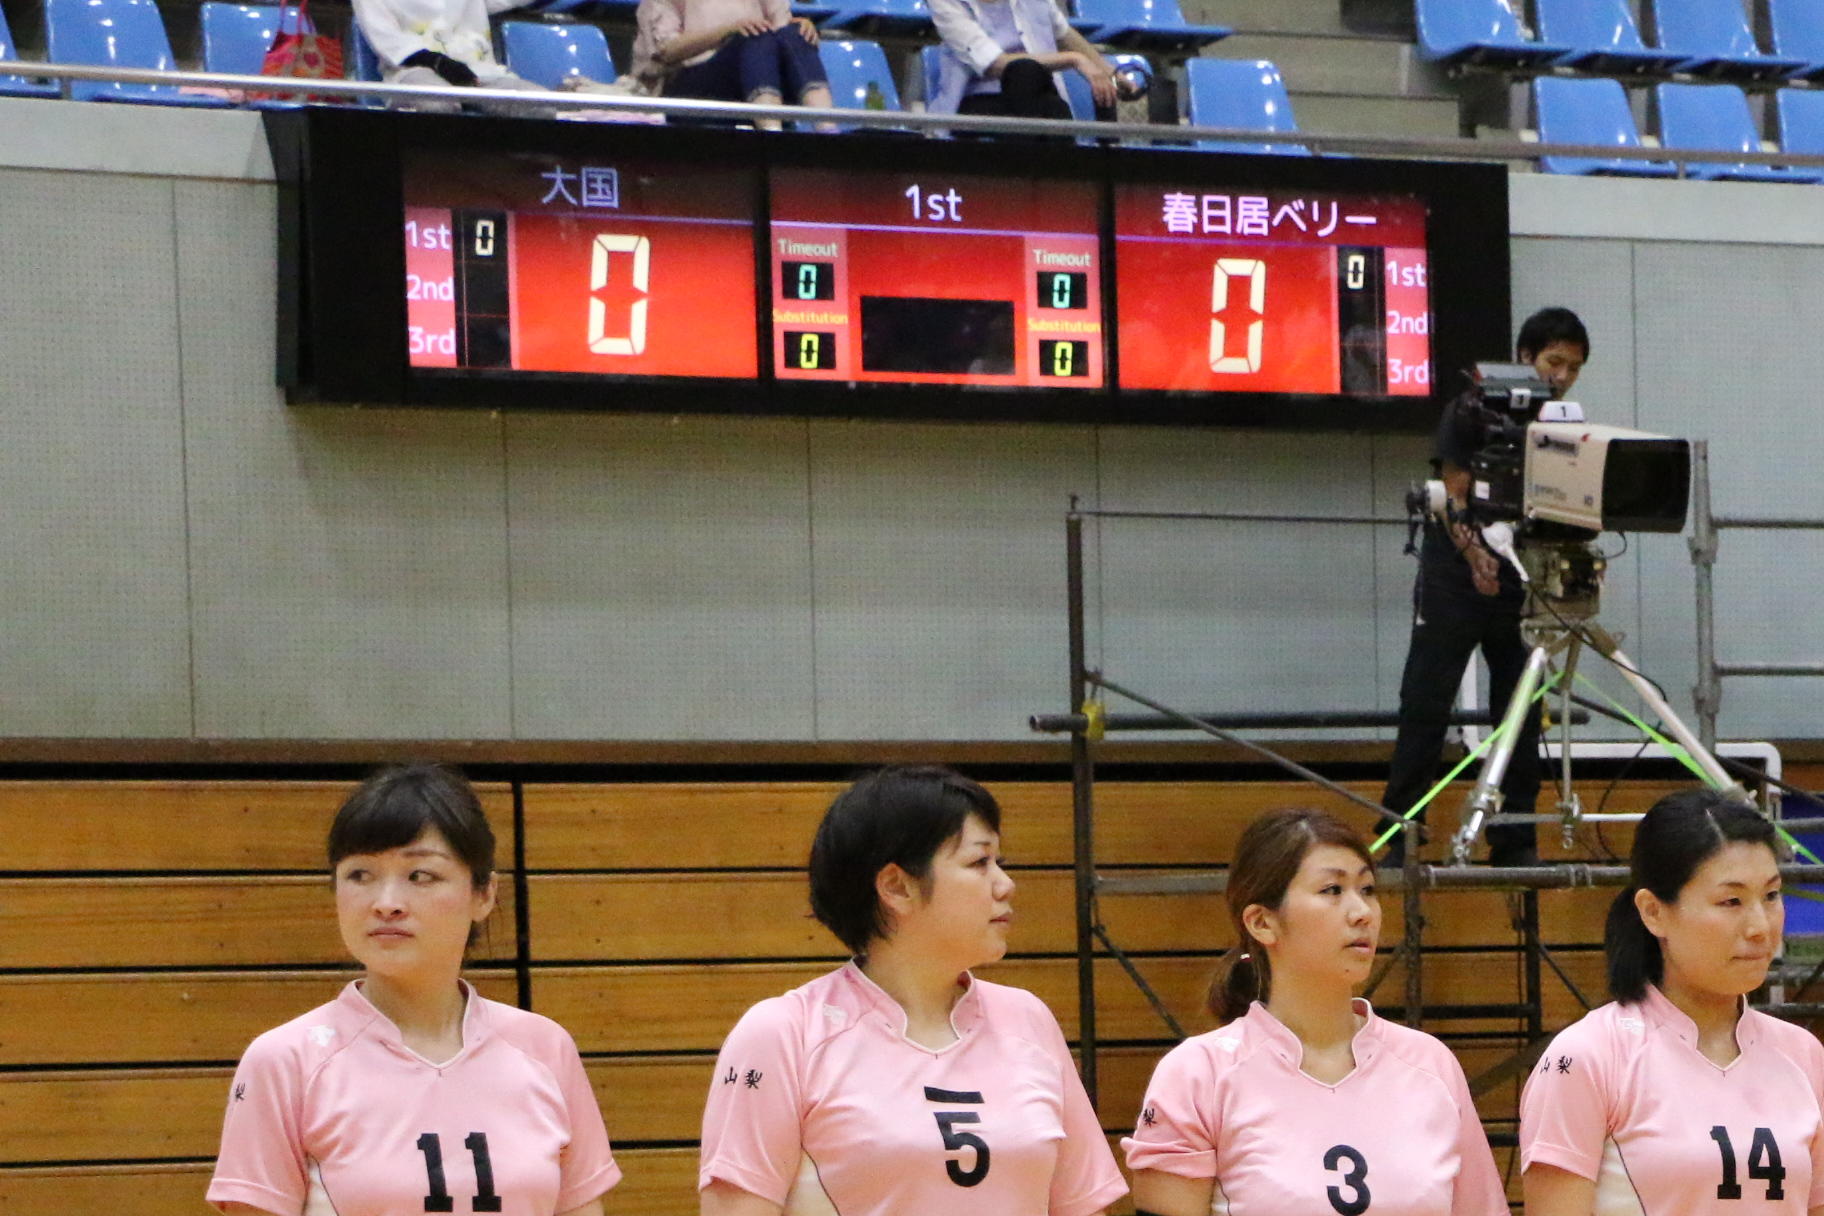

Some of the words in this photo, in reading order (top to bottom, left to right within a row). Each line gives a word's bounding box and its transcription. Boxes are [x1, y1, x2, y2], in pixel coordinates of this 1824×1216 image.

[541, 165, 619, 208] 大国
[905, 184, 963, 222] 1st
[1162, 192, 1377, 238] 春日居ベリー
[405, 220, 452, 249] 1st
[475, 219, 495, 256] 0
[777, 238, 838, 257] Timeout
[1033, 249, 1091, 268] Timeout
[1347, 255, 1365, 289] 0
[1386, 260, 1428, 287] 1st
[406, 274, 454, 301] 2nd
[588, 233, 651, 356] 0
[798, 263, 817, 300] 0
[1052, 273, 1071, 309] 0
[773, 308, 848, 325] Substitution
[1027, 317, 1100, 334] Substitution
[1209, 257, 1267, 374] 0
[1387, 310, 1429, 335] 2nd
[408, 326, 457, 354] 3rd
[800, 333, 820, 369] 0
[1053, 341, 1073, 377] 0
[1388, 358, 1430, 383] 3rd
[1559, 405, 1567, 418] 1
[724, 1065, 763, 1091] 山梨
[1540, 1055, 1573, 1075] 山梨
[923, 1086, 991, 1188] 5
[415, 1132, 503, 1213] 11
[1709, 1125, 1787, 1201] 14
